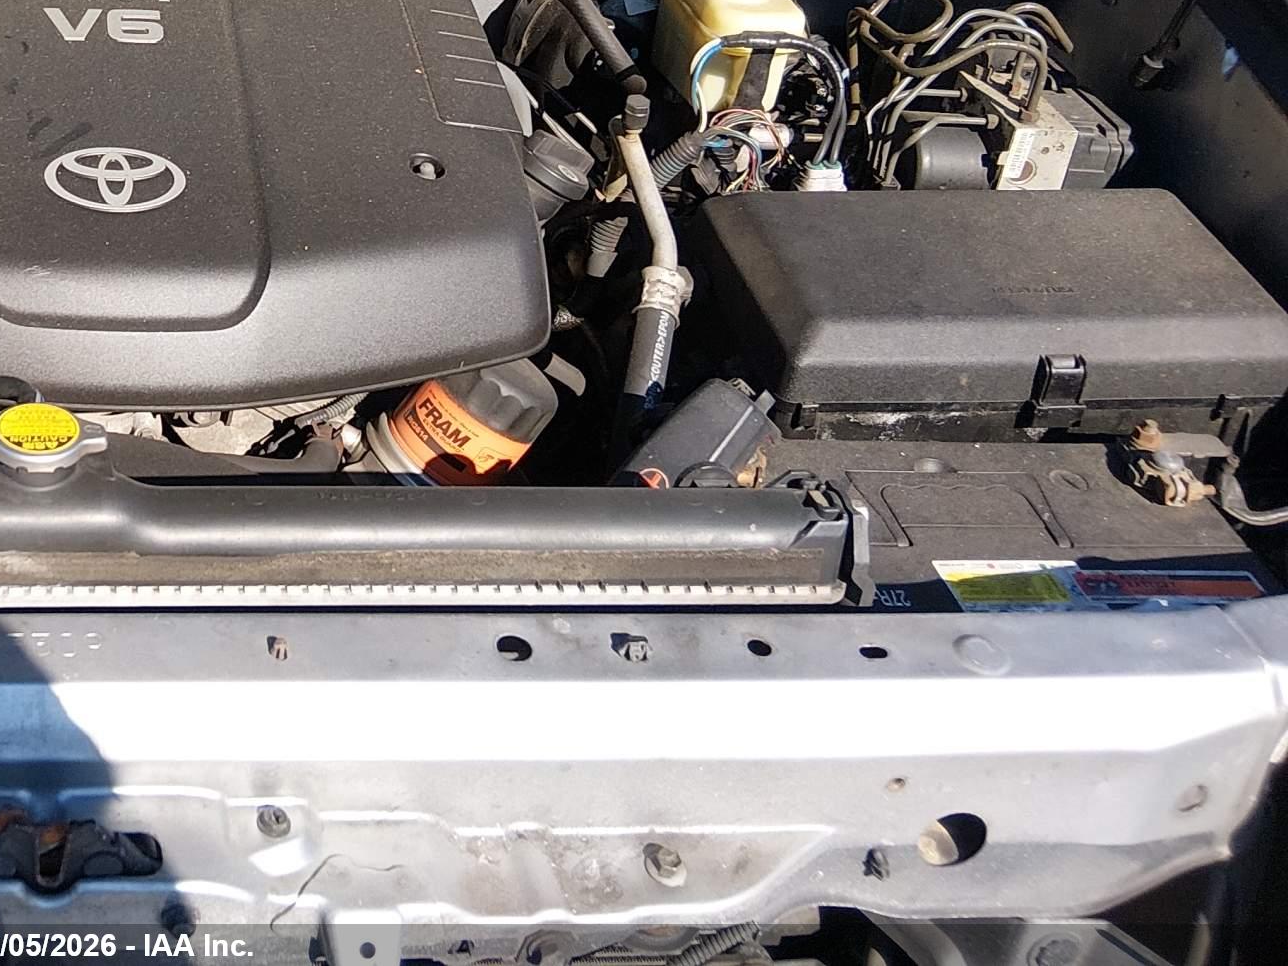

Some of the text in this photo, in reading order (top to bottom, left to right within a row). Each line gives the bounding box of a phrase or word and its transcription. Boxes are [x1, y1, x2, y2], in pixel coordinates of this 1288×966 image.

[42, 7, 165, 44] V6
[9, 435, 68, 443] CAUTION
[418, 396, 472, 449] FRAM
